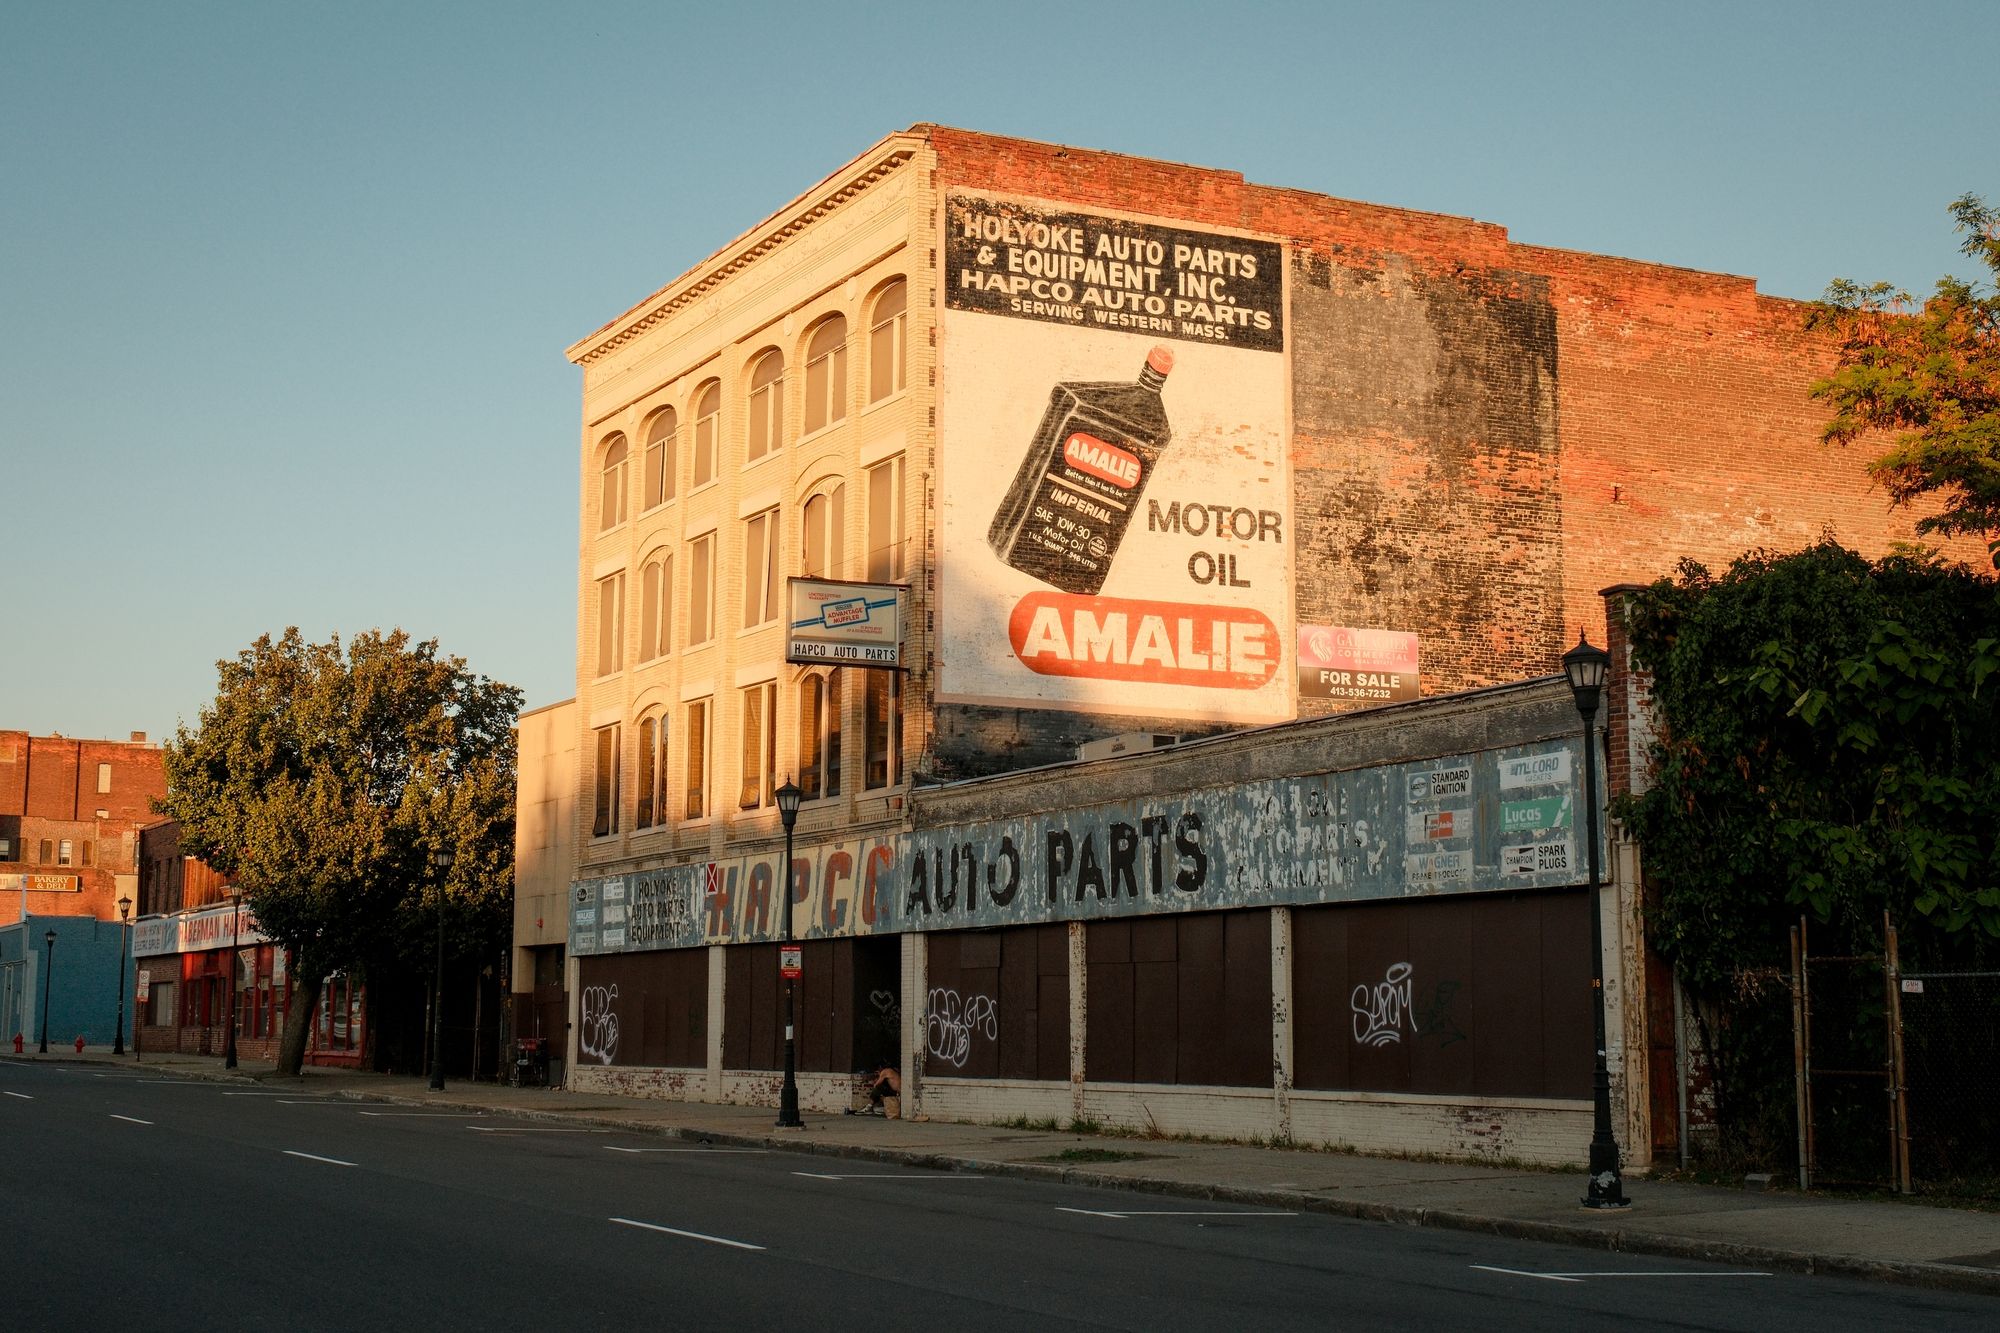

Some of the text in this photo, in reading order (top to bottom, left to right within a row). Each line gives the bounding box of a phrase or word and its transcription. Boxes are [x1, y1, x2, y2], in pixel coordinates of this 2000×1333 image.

[964, 212, 1257, 279] HOLYOKE AUTO PARTS
[977, 246, 996, 265] &
[1179, 275, 1236, 305] INC.
[960, 269, 1272, 330] HAPCO AUTO PARTS
[1011, 298, 1229, 340] SERVING WESTERN MASS.
[1066, 438, 1140, 485] AMALIE
[1064, 468, 1084, 481] Better
[1050, 488, 1111, 524] IMPERIAL
[1035, 506, 1090, 540] SAE 10W-30
[1148, 499, 1283, 543] MOTOR
[1042, 526, 1070, 547] Motor
[1070, 537, 1084, 552] Oil
[1044, 540, 1065, 553] QUART
[1188, 550, 1251, 588] OIL
[828, 607, 864, 619] ADVANTAGE
[833, 614, 860, 624] MUFFLER
[1021, 606, 1269, 675] AMALIE
[794, 643, 896, 661] HAPCO AUTO PARTS
[1338, 649, 1409, 662] COMMERCIAL
[1320, 670, 1400, 688] FOR SALE
[1330, 686, 1391, 698] 413-536-7232
[1431, 769, 1470, 784] STANDARD
[1433, 782, 1466, 795] IGNITION
[1505, 807, 1542, 824] Lucas
[1506, 855, 1533, 865] CHAMPION
[1538, 844, 1566, 857] SPARK
[906, 836, 1020, 916] AUTO
[1048, 812, 1207, 903] PARTS
[1418, 855, 1460, 869] WAGNER
[1538, 857, 1567, 870] PLUGS
[638, 877, 677, 898] HOLYOKE
[631, 901, 654, 921] AUTO
[657, 899, 685, 919] PARTS
[631, 921, 680, 944] EQUIPMENT
